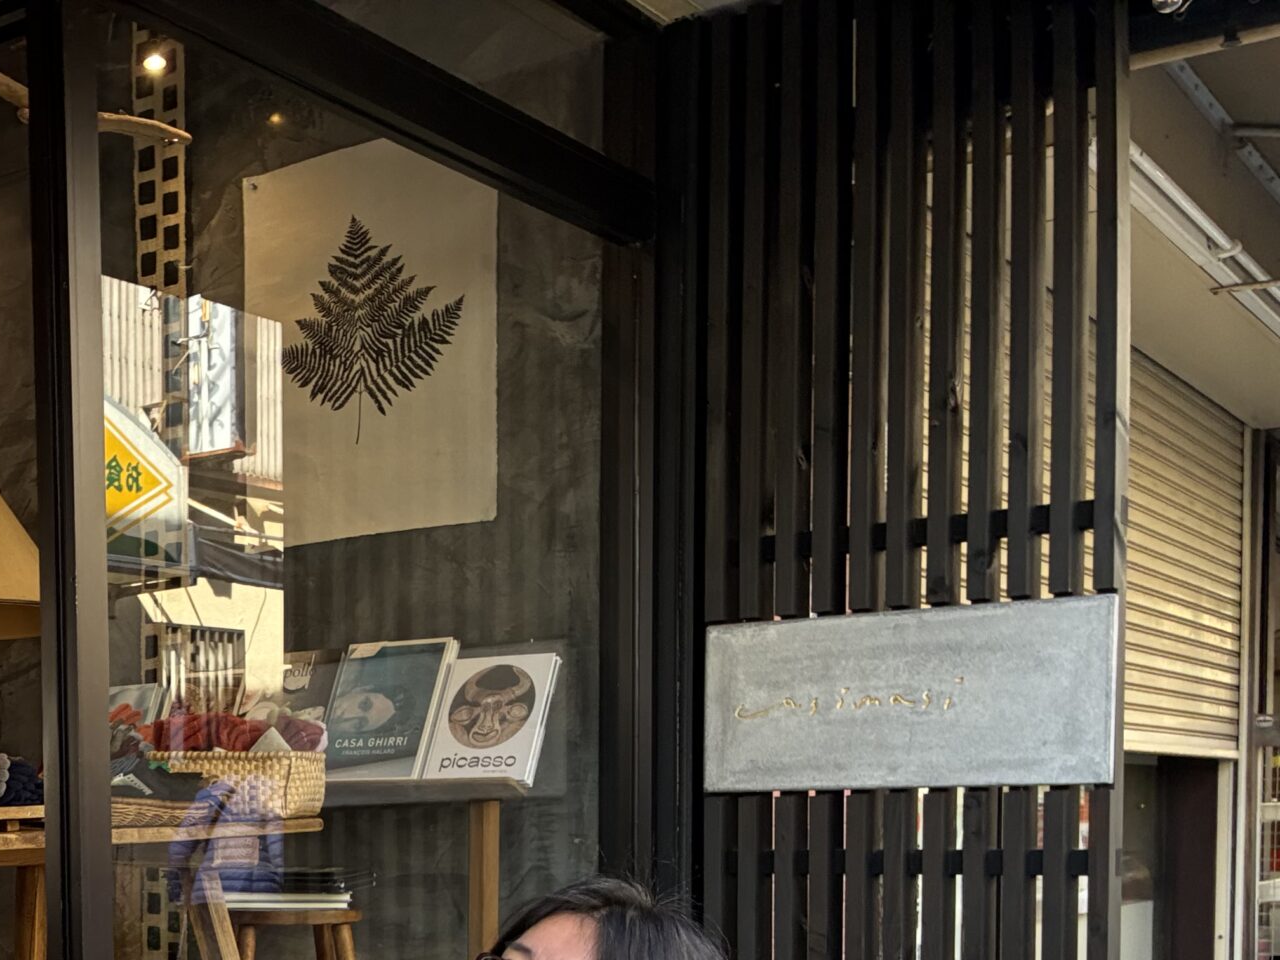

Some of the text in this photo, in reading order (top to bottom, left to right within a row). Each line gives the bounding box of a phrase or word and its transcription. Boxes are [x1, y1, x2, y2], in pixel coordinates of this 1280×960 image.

[334, 736, 408, 749] CASA GHIRRI
[438, 753, 517, 773] picasso
